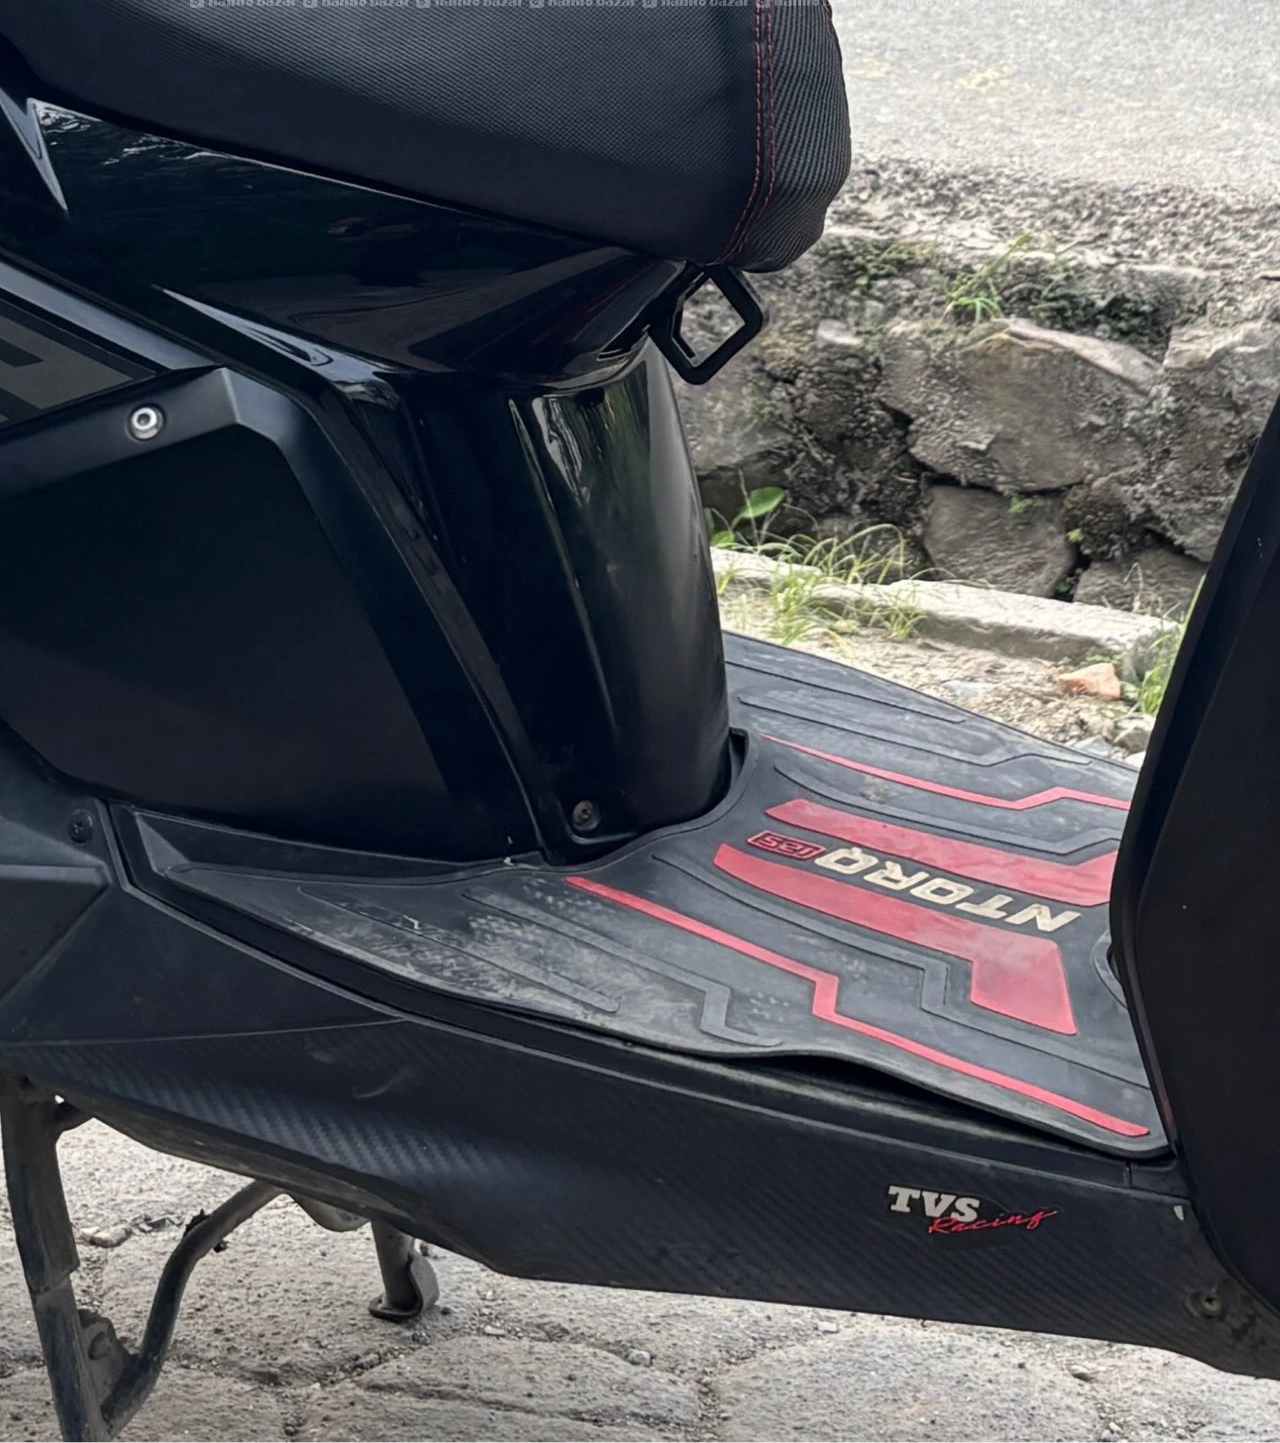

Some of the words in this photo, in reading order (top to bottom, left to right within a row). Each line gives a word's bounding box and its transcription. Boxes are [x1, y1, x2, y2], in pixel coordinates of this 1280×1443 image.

[814, 846, 1084, 932] NTORQ
[887, 1185, 980, 1222] TVS
[927, 1210, 1058, 1234] Racing
